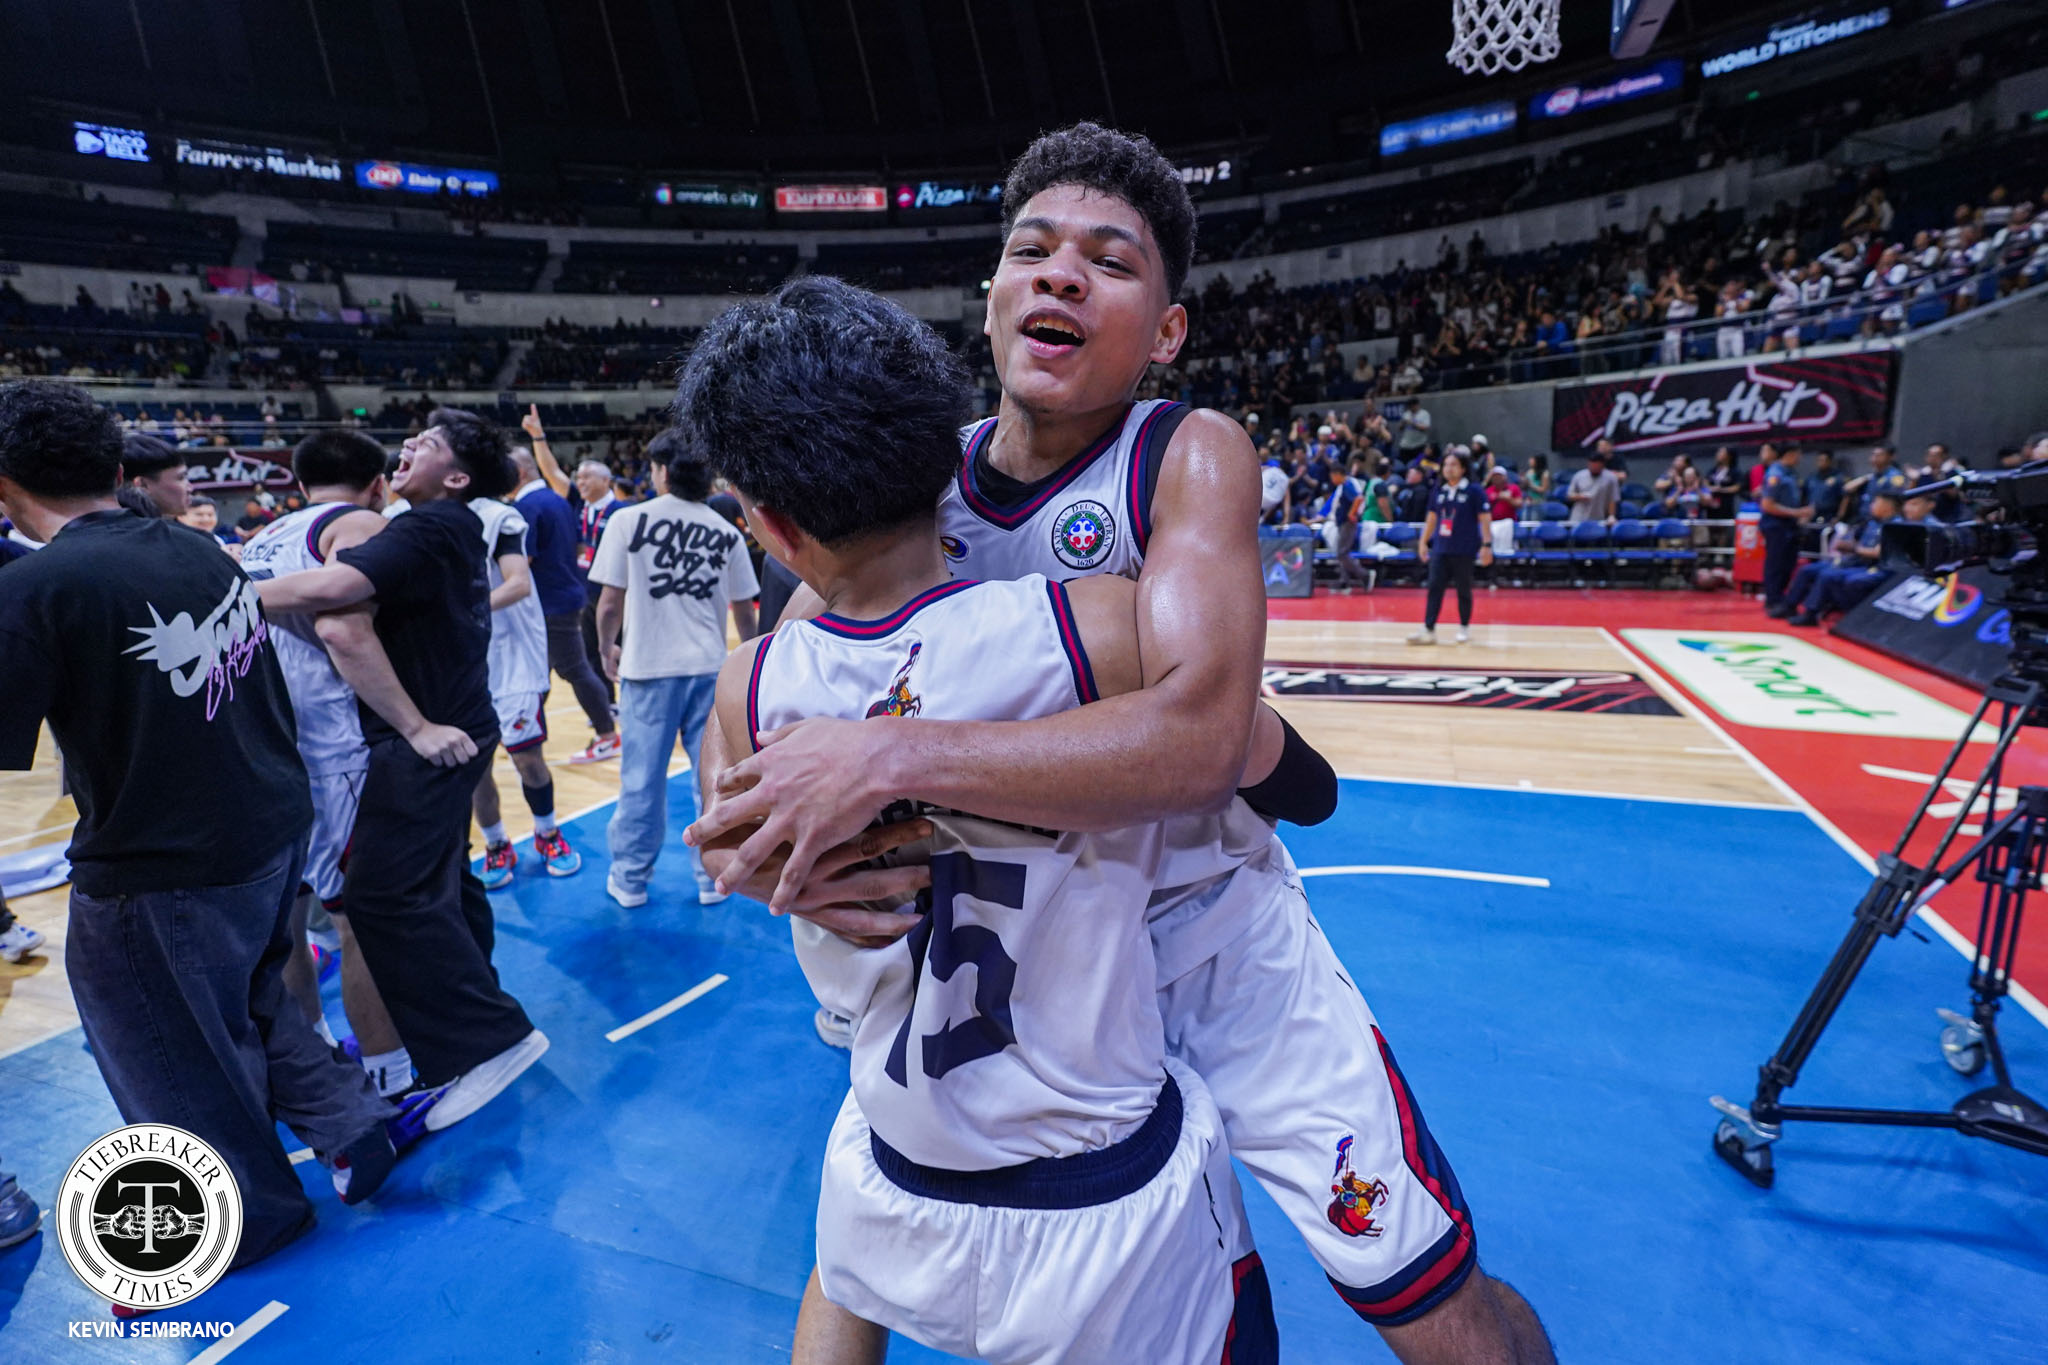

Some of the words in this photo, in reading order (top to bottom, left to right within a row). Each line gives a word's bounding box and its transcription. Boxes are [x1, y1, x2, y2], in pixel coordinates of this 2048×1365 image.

[1701, 41, 1777, 78] WORLD
[100, 131, 147, 151] TACO
[104, 143, 150, 162] BELL
[266, 155, 341, 181] Market
[1217, 160, 1231, 180] 2
[730, 190, 758, 207] city
[785, 190, 877, 205] EMPERADOR
[914, 182, 965, 208] Pizza
[1604, 390, 1714, 438] Pizza
[1716, 380, 1821, 428] Hut
[211, 457, 281, 485] Hut
[1071, 504, 1096, 513] DEUS
[628, 512, 739, 553] LONDON
[1077, 558, 1094, 567] 1620
[1339, 673, 1576, 698] Pizza
[884, 851, 1027, 1088] 15
